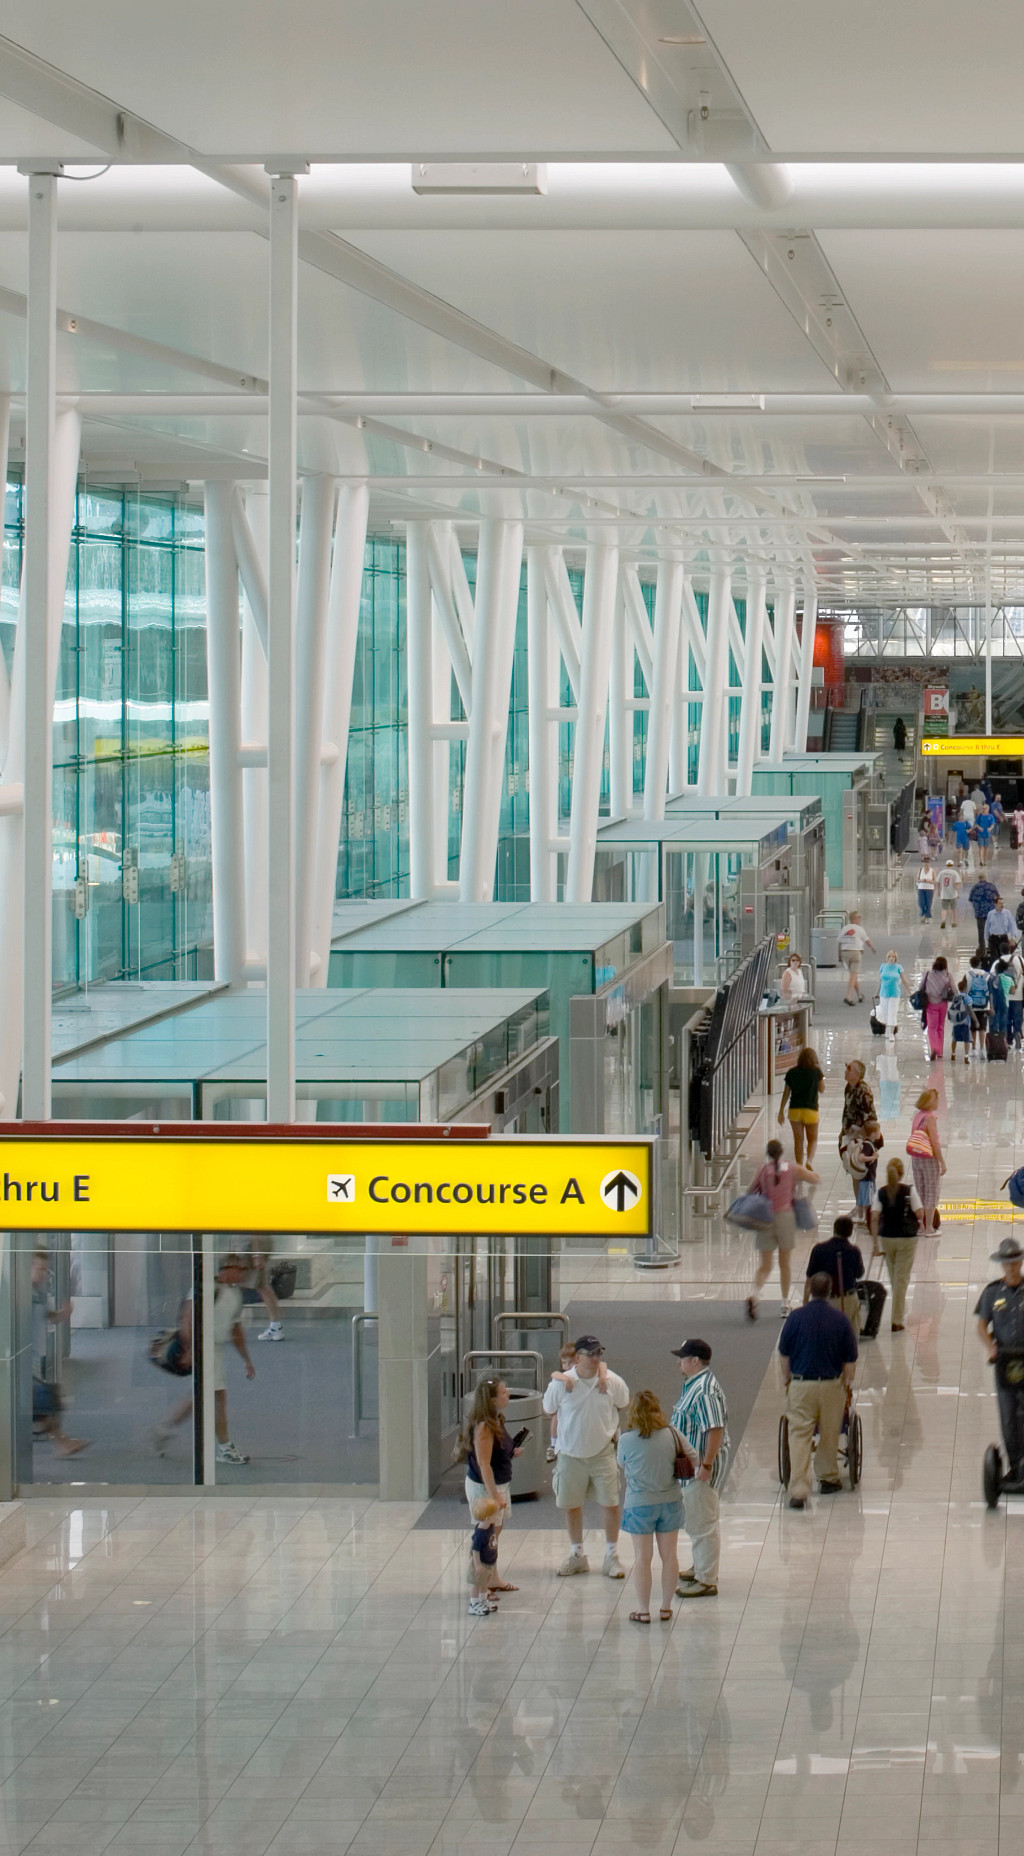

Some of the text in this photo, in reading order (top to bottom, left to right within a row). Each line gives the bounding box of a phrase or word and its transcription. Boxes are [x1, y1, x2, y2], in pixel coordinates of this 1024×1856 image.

[940, 743, 974, 751] Concourse
[0, 1172, 90, 1202] hru E
[368, 1175, 585, 1205] Concourse A
